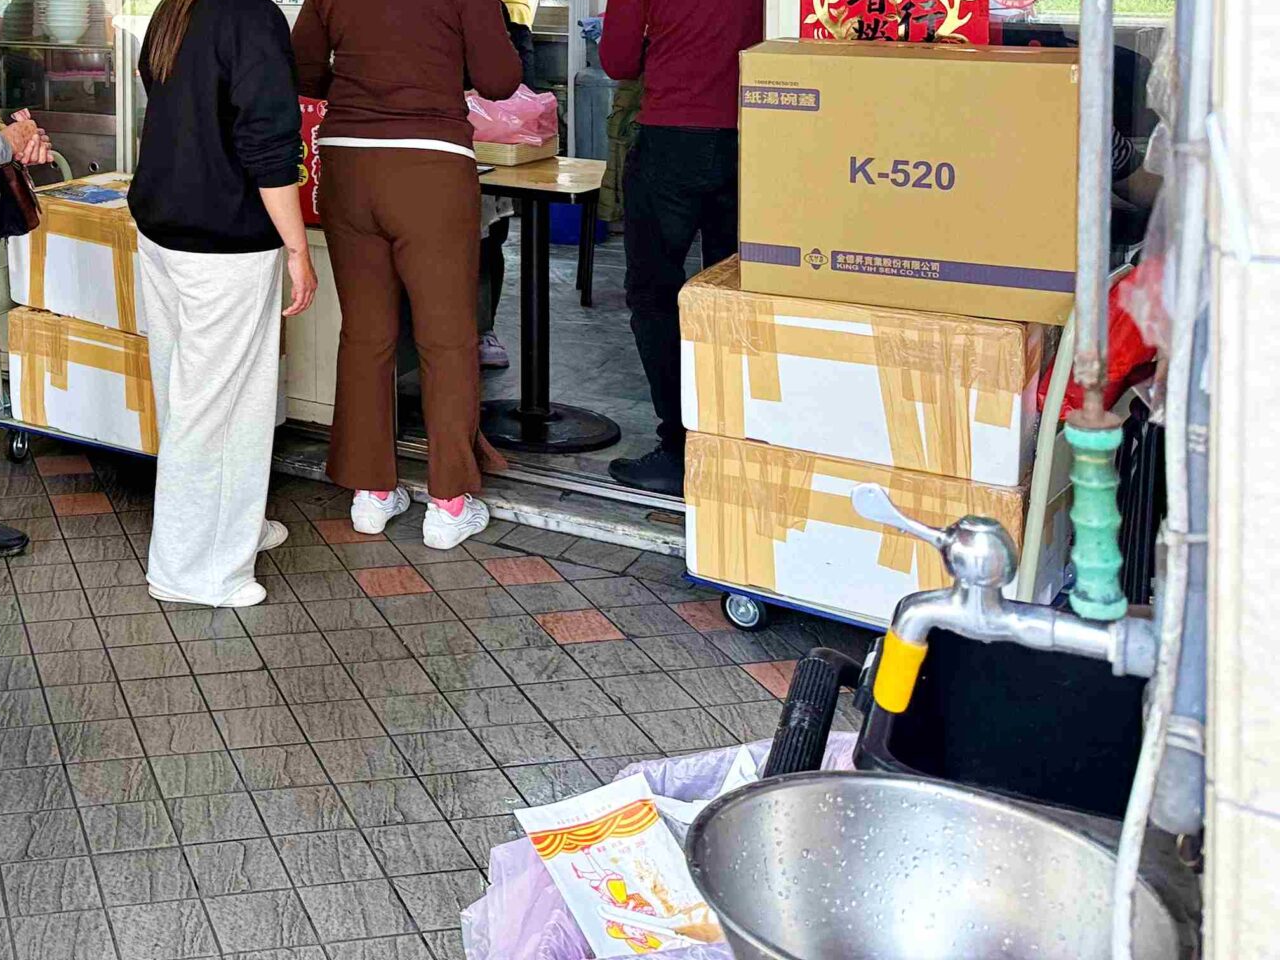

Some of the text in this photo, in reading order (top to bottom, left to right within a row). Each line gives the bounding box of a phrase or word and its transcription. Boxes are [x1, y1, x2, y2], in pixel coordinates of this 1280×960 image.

[744, 90, 817, 107] 紙湯碗蓋
[849, 156, 956, 191] K-520
[836, 263, 859, 272] KING
[861, 265, 877, 273] YIH
[879, 267, 898, 275] SEN
